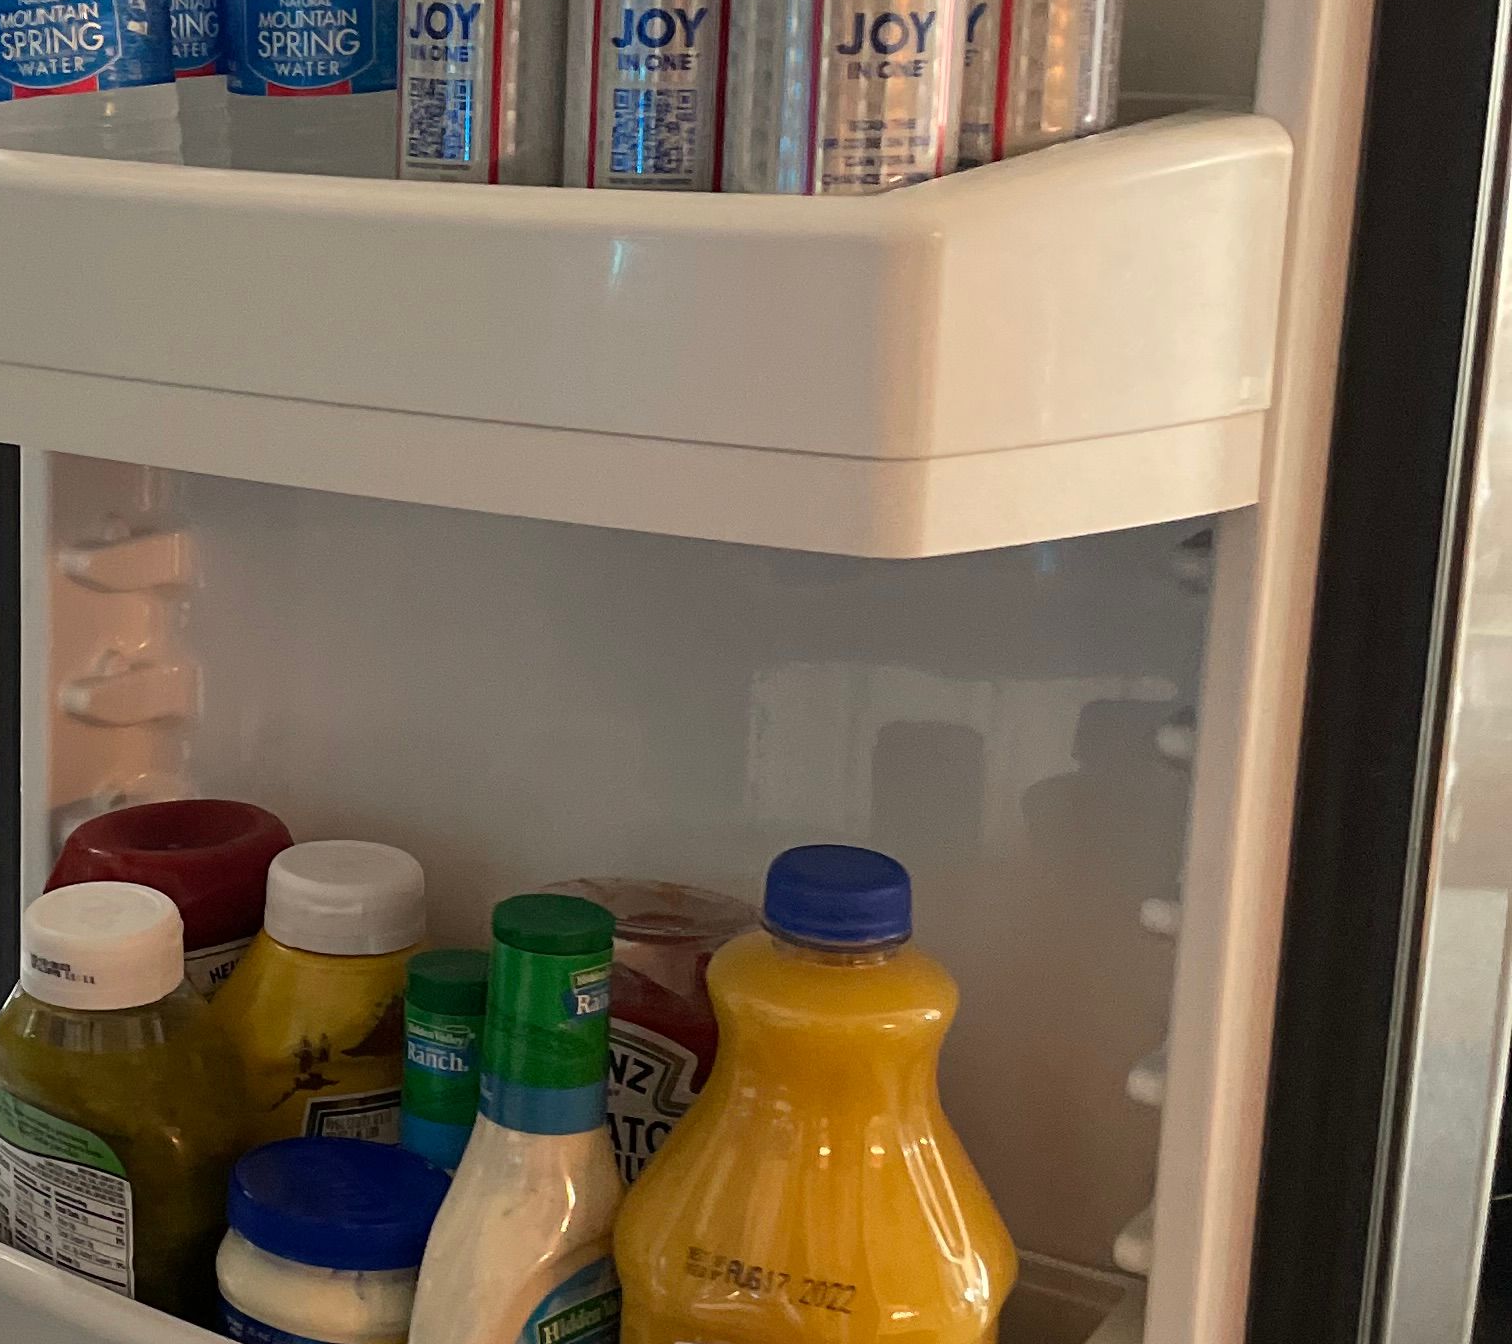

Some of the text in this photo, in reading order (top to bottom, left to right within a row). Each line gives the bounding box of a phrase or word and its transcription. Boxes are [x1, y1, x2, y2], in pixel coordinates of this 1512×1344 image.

[0, 2, 99, 29] MOUNTAIN
[258, 8, 358, 29] MOUNTAIN
[409, 2, 481, 40] JOY
[612, 8, 708, 48] JOY
[0, 22, 104, 61] SPRING
[258, 28, 361, 58] SPRING
[837, 11, 936, 55] JOY
[172, 41, 209, 58] ATER
[645, 54, 693, 71] ONE
[17, 56, 86, 77] WATER
[274, 60, 341, 77] WATER
[799, 1279, 856, 1314] 2022
